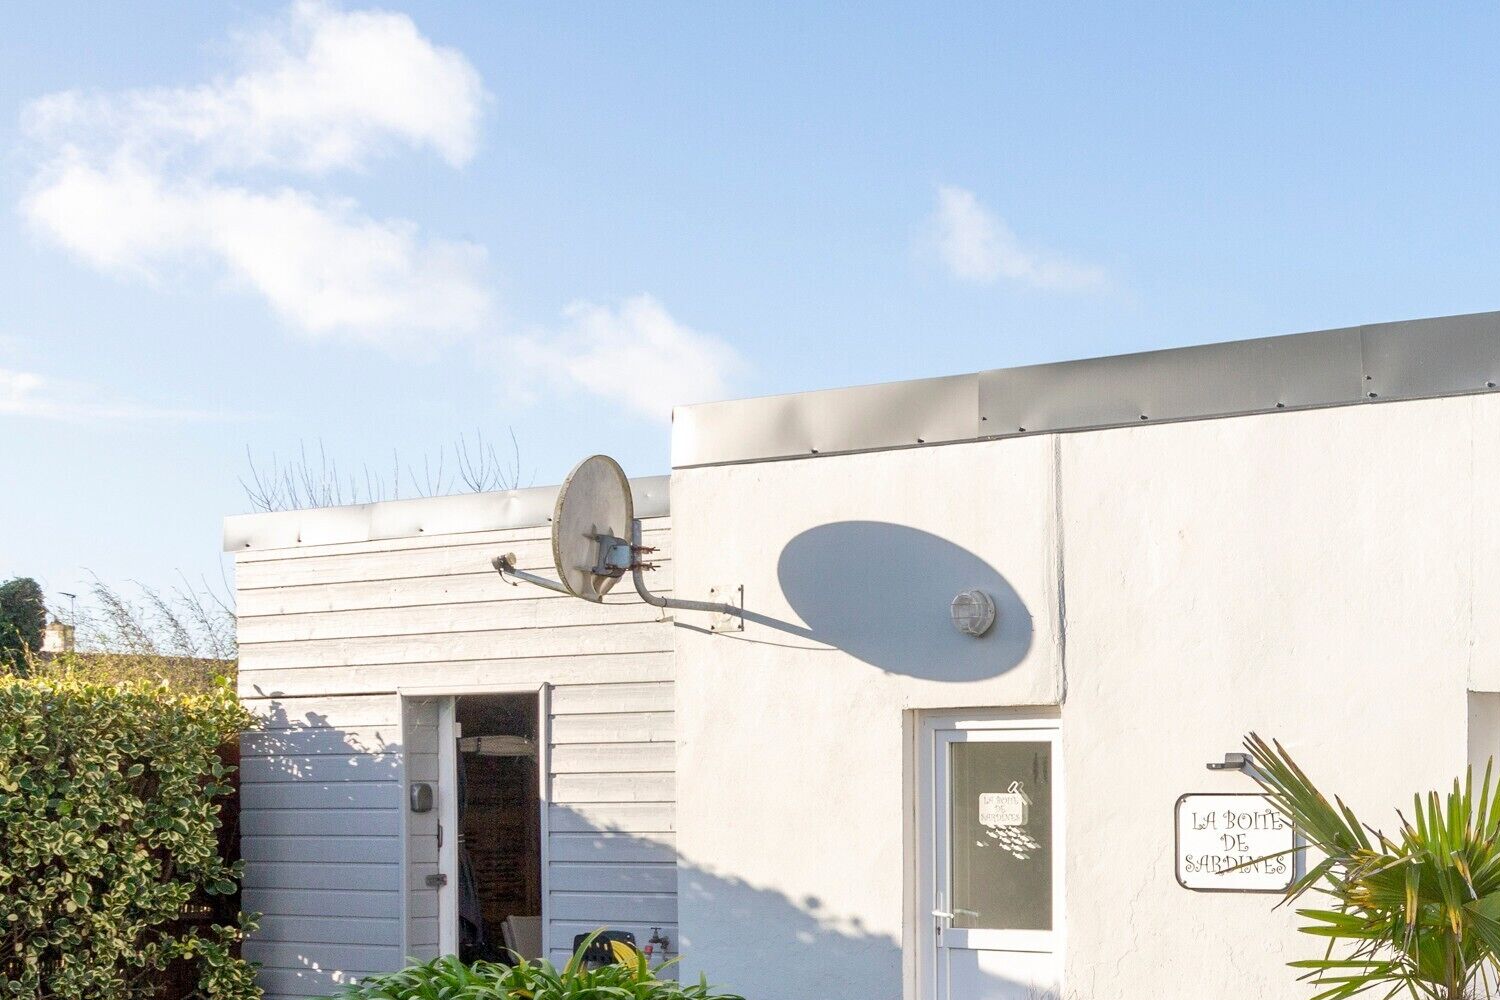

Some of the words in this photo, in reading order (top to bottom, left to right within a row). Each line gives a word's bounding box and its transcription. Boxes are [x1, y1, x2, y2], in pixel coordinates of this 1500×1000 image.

[1192, 811, 1217, 830] LA
[1223, 808, 1283, 830] BOITE
[1220, 833, 1249, 852] DE
[1185, 854, 1287, 876] SARDINES
